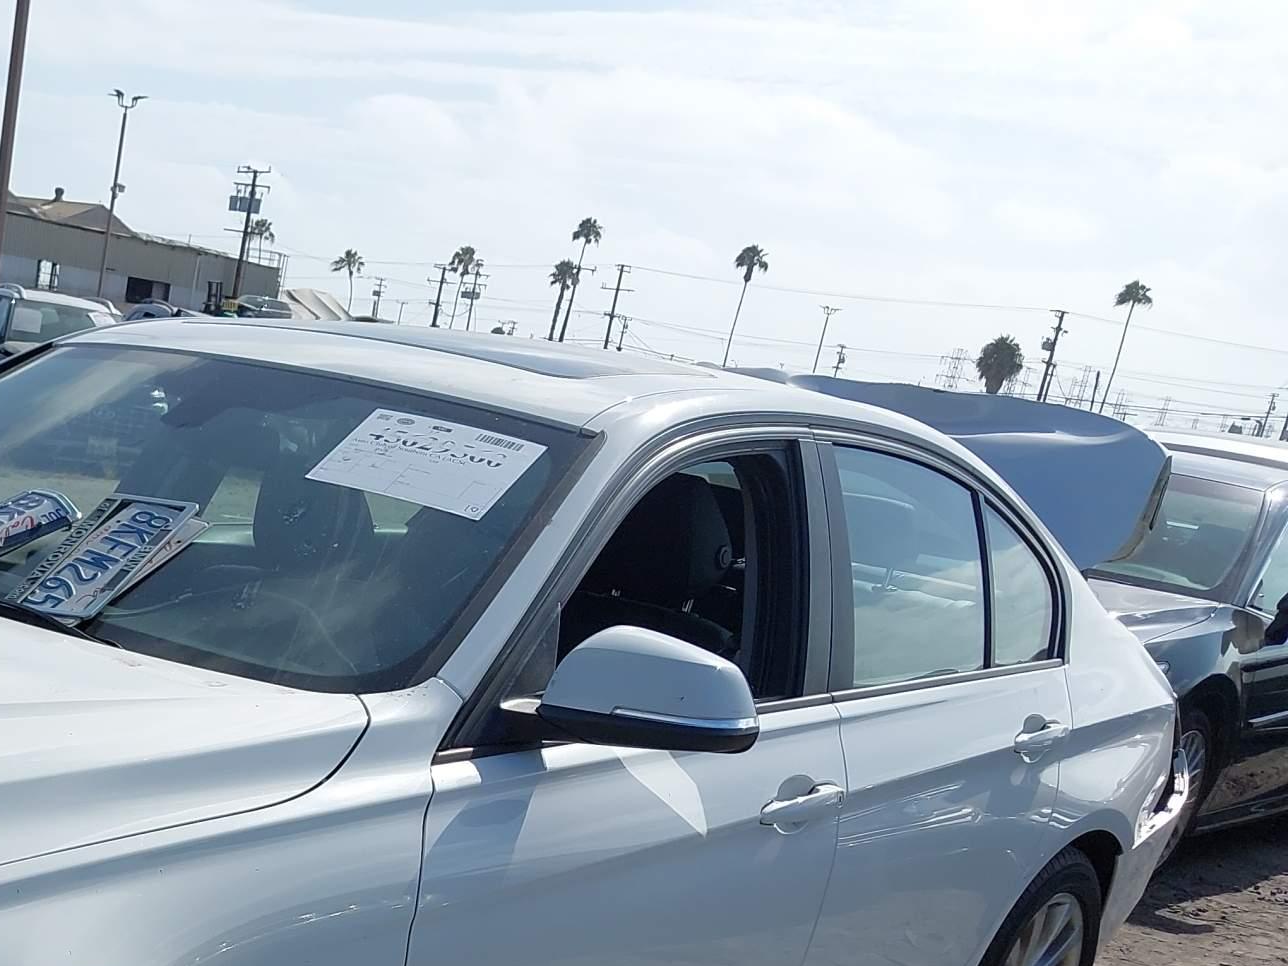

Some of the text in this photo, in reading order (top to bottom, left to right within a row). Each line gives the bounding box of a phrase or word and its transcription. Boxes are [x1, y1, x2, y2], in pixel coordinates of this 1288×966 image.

[40, 507, 64, 525] JUL
[25, 510, 173, 610] 8KFM265
[124, 545, 155, 572] BMW
